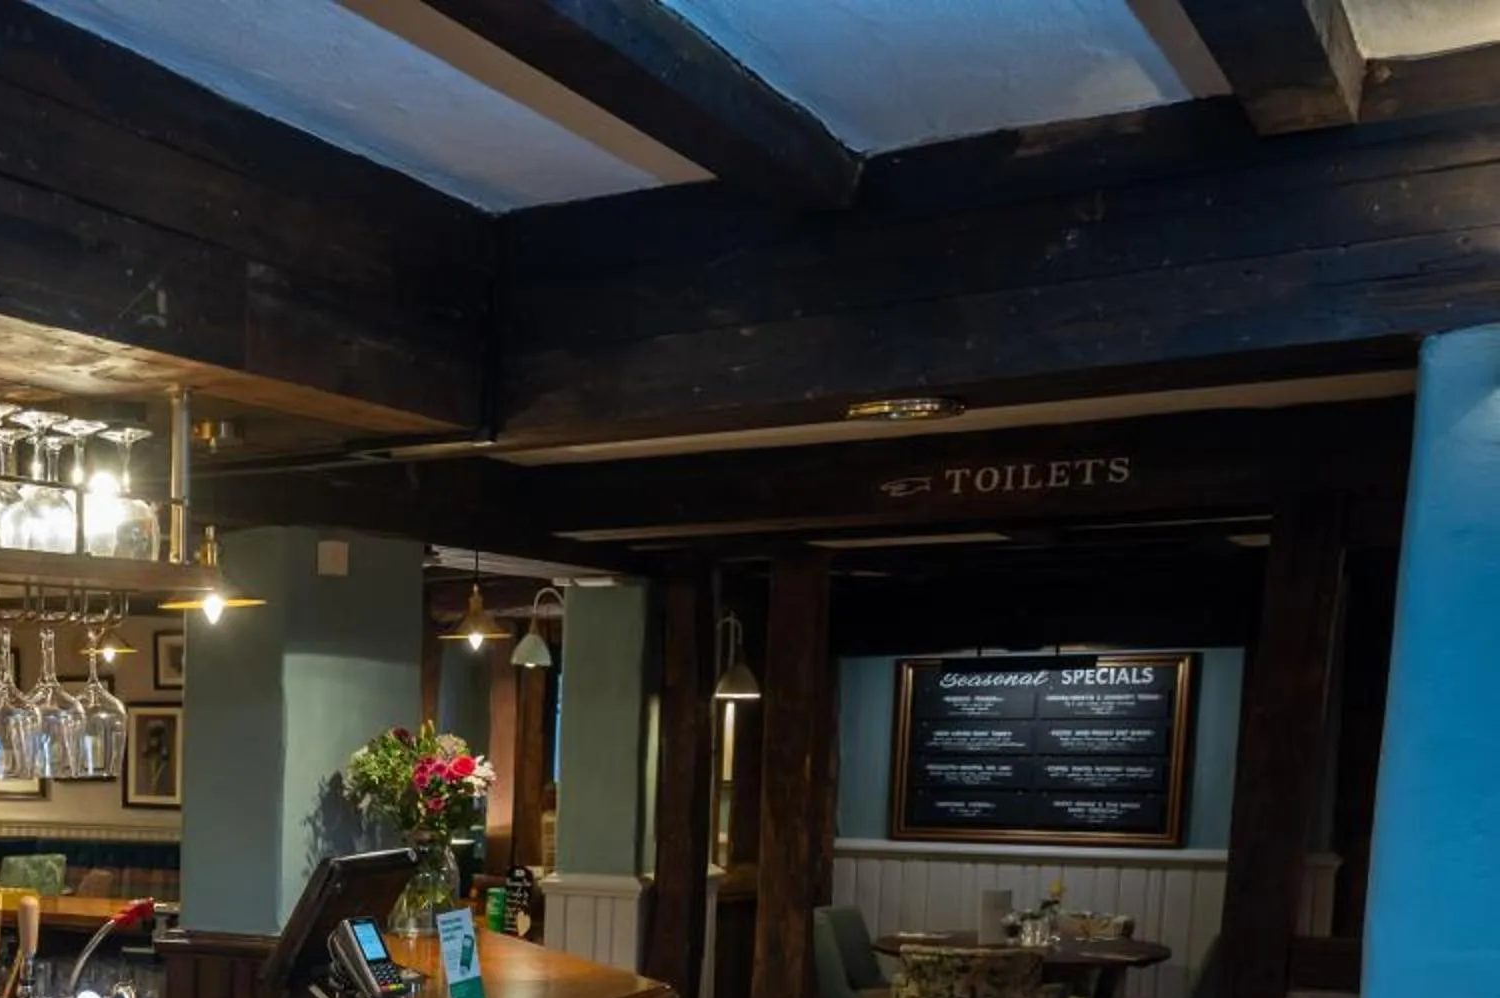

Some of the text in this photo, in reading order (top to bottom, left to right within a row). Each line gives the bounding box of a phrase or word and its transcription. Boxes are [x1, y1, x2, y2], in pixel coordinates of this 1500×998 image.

[945, 457, 1130, 494] TOILETS
[939, 667, 1154, 689] Seasonal SPECIALS
